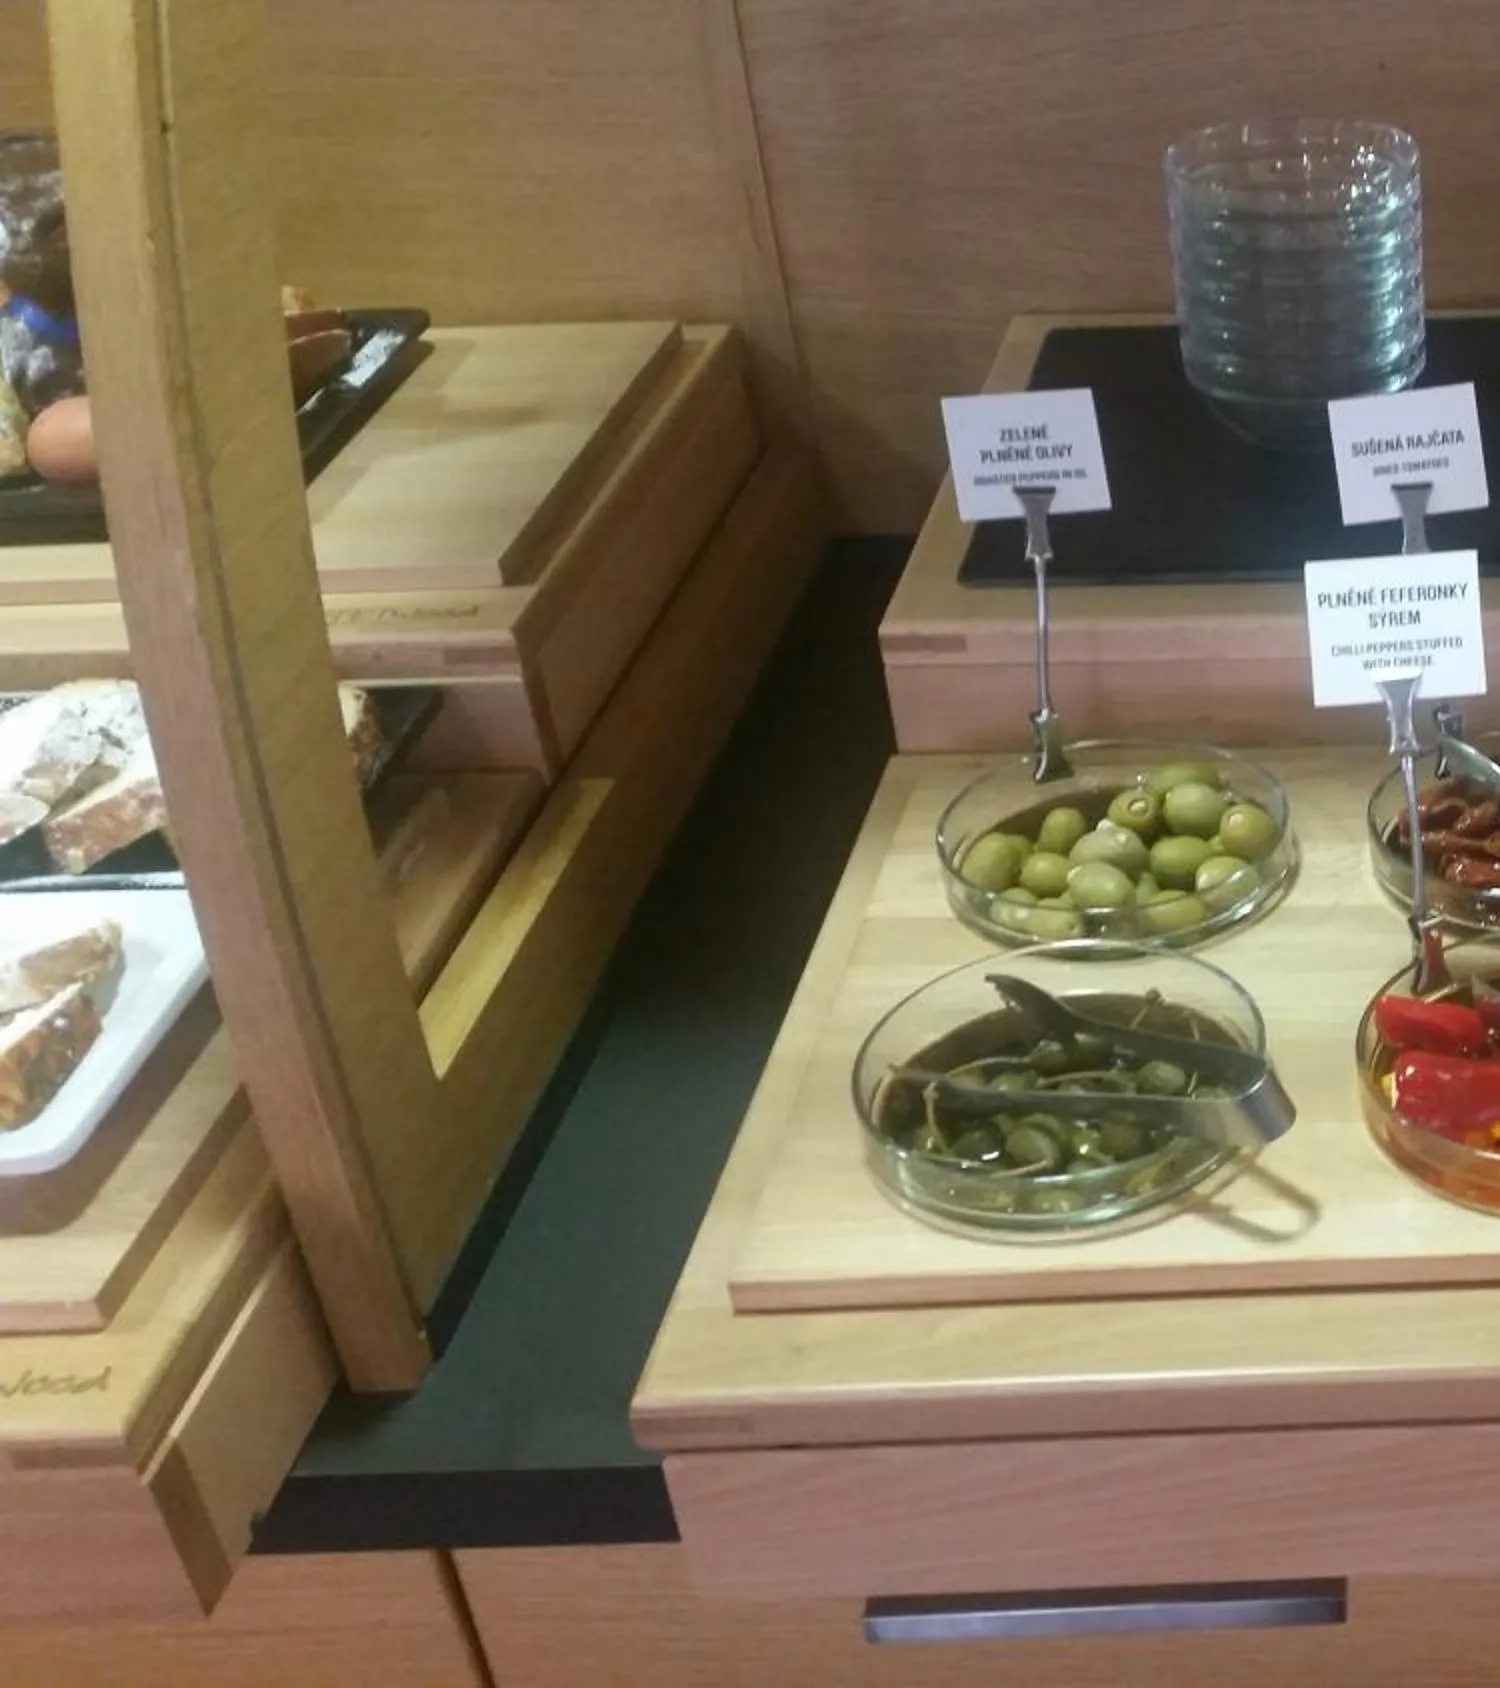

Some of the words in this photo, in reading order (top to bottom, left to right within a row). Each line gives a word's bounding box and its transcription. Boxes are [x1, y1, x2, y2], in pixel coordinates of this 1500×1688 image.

[1317, 586, 1376, 609] PLNĚNÉ
[1380, 581, 1469, 605] FEFERONKY
[1365, 639, 1415, 654] PEPPERS
[1416, 635, 1463, 650] STUFFED
[1362, 658, 1391, 670] WITH
